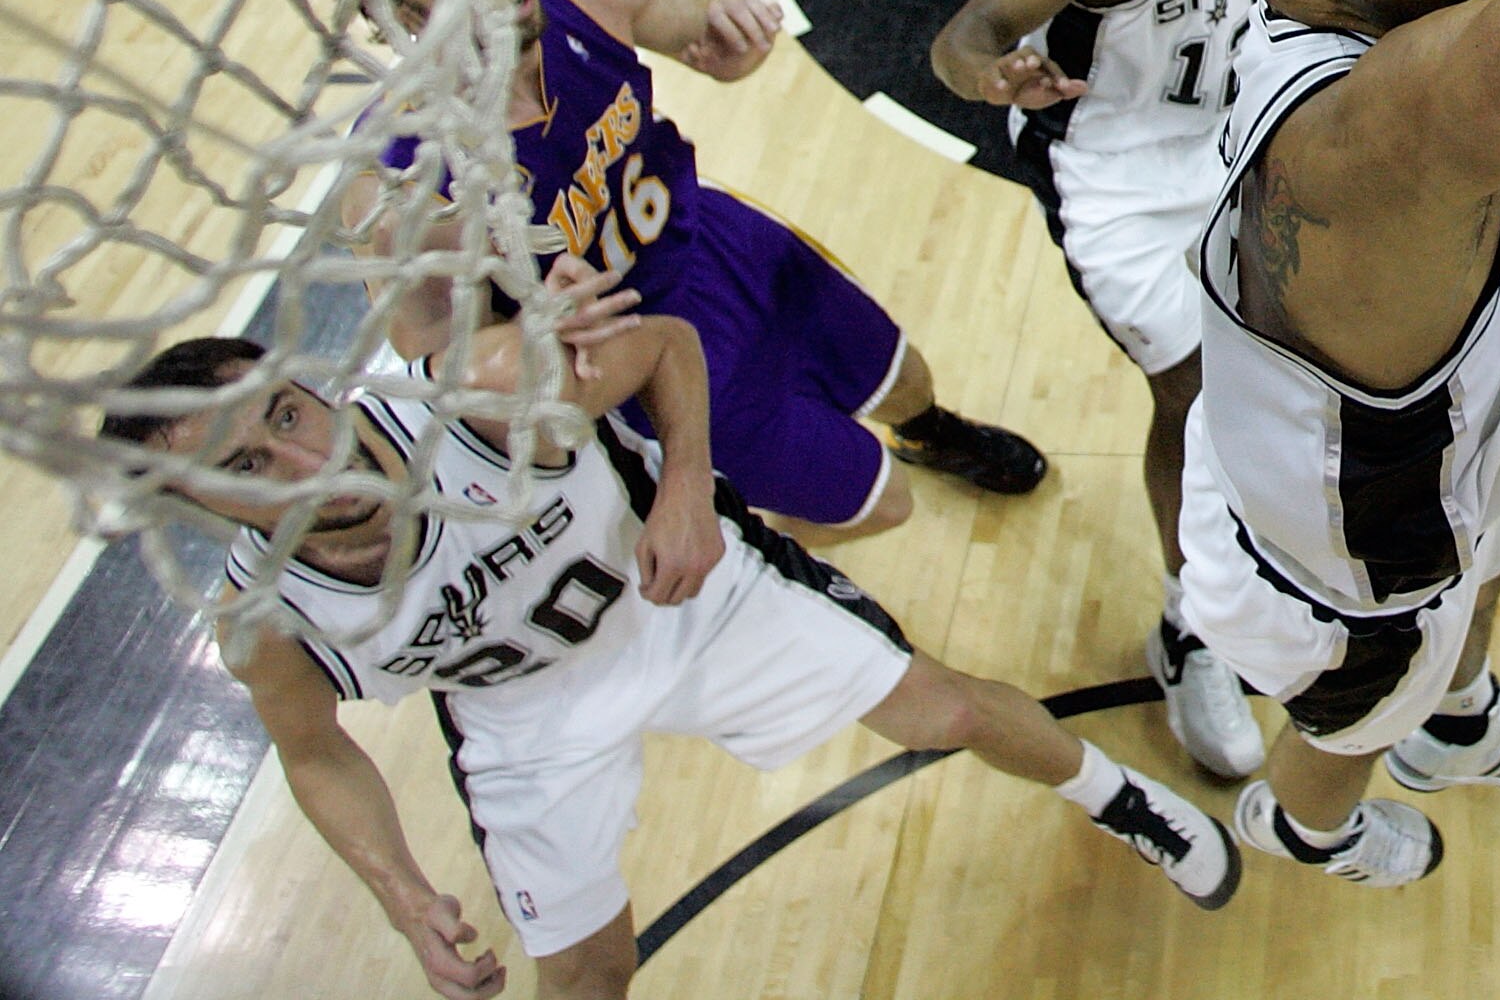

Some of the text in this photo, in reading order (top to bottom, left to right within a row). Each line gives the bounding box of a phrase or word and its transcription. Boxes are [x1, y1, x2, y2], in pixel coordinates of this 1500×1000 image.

[598, 151, 671, 274] 16
[376, 491, 576, 677] SPURS
[431, 551, 631, 689] 20
